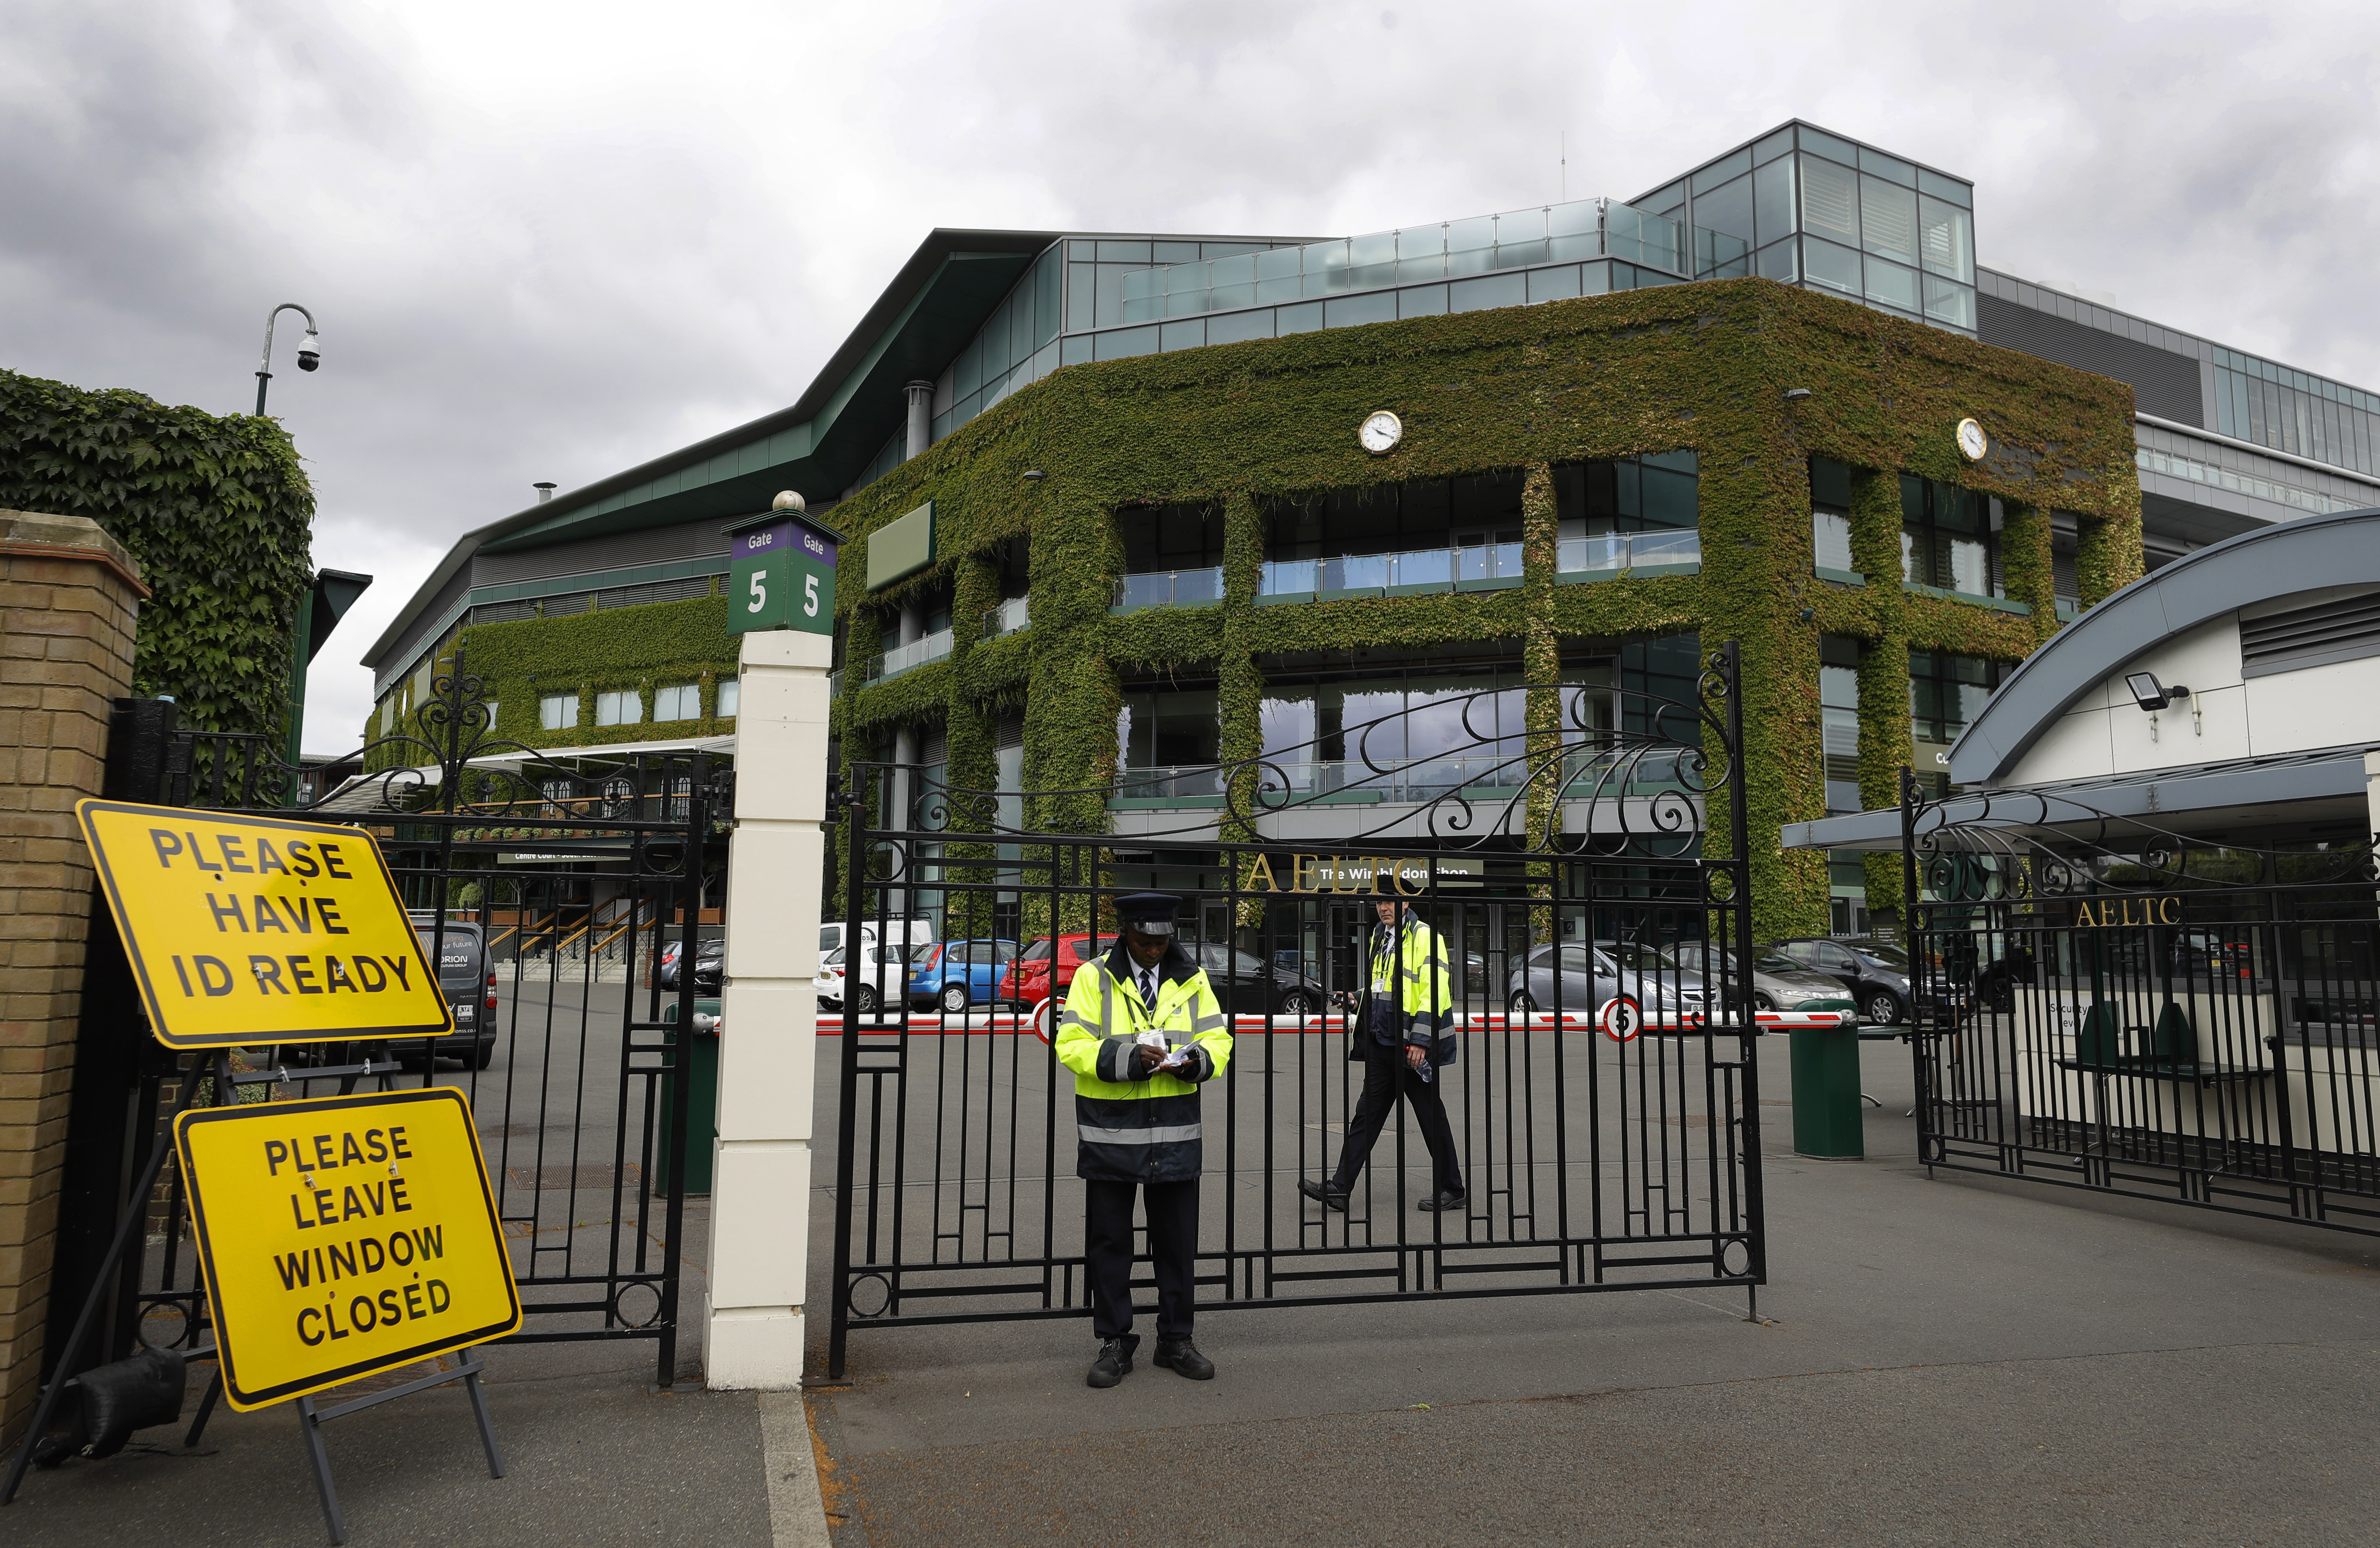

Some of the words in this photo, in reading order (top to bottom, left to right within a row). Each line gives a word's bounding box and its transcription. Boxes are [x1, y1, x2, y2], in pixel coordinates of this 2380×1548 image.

[748, 533, 772, 549] Gate
[804, 534, 824, 555] Gate
[747, 569, 767, 614] 5
[803, 573, 819, 618] 5
[149, 828, 353, 879] PLEASE
[1242, 853, 1425, 896] AELTC
[1320, 869, 1345, 880] The
[205, 892, 350, 934] HAVE
[2075, 897, 2180, 927] AELTC
[172, 954, 234, 997] ID
[249, 954, 413, 994] READY
[2050, 1003, 2087, 1016] Scuty
[264, 1125, 412, 1176] PLEASE
[291, 1178, 412, 1229] LEAVE
[274, 1224, 443, 1291] WINDOW
[297, 1278, 450, 1347] CLOSED
